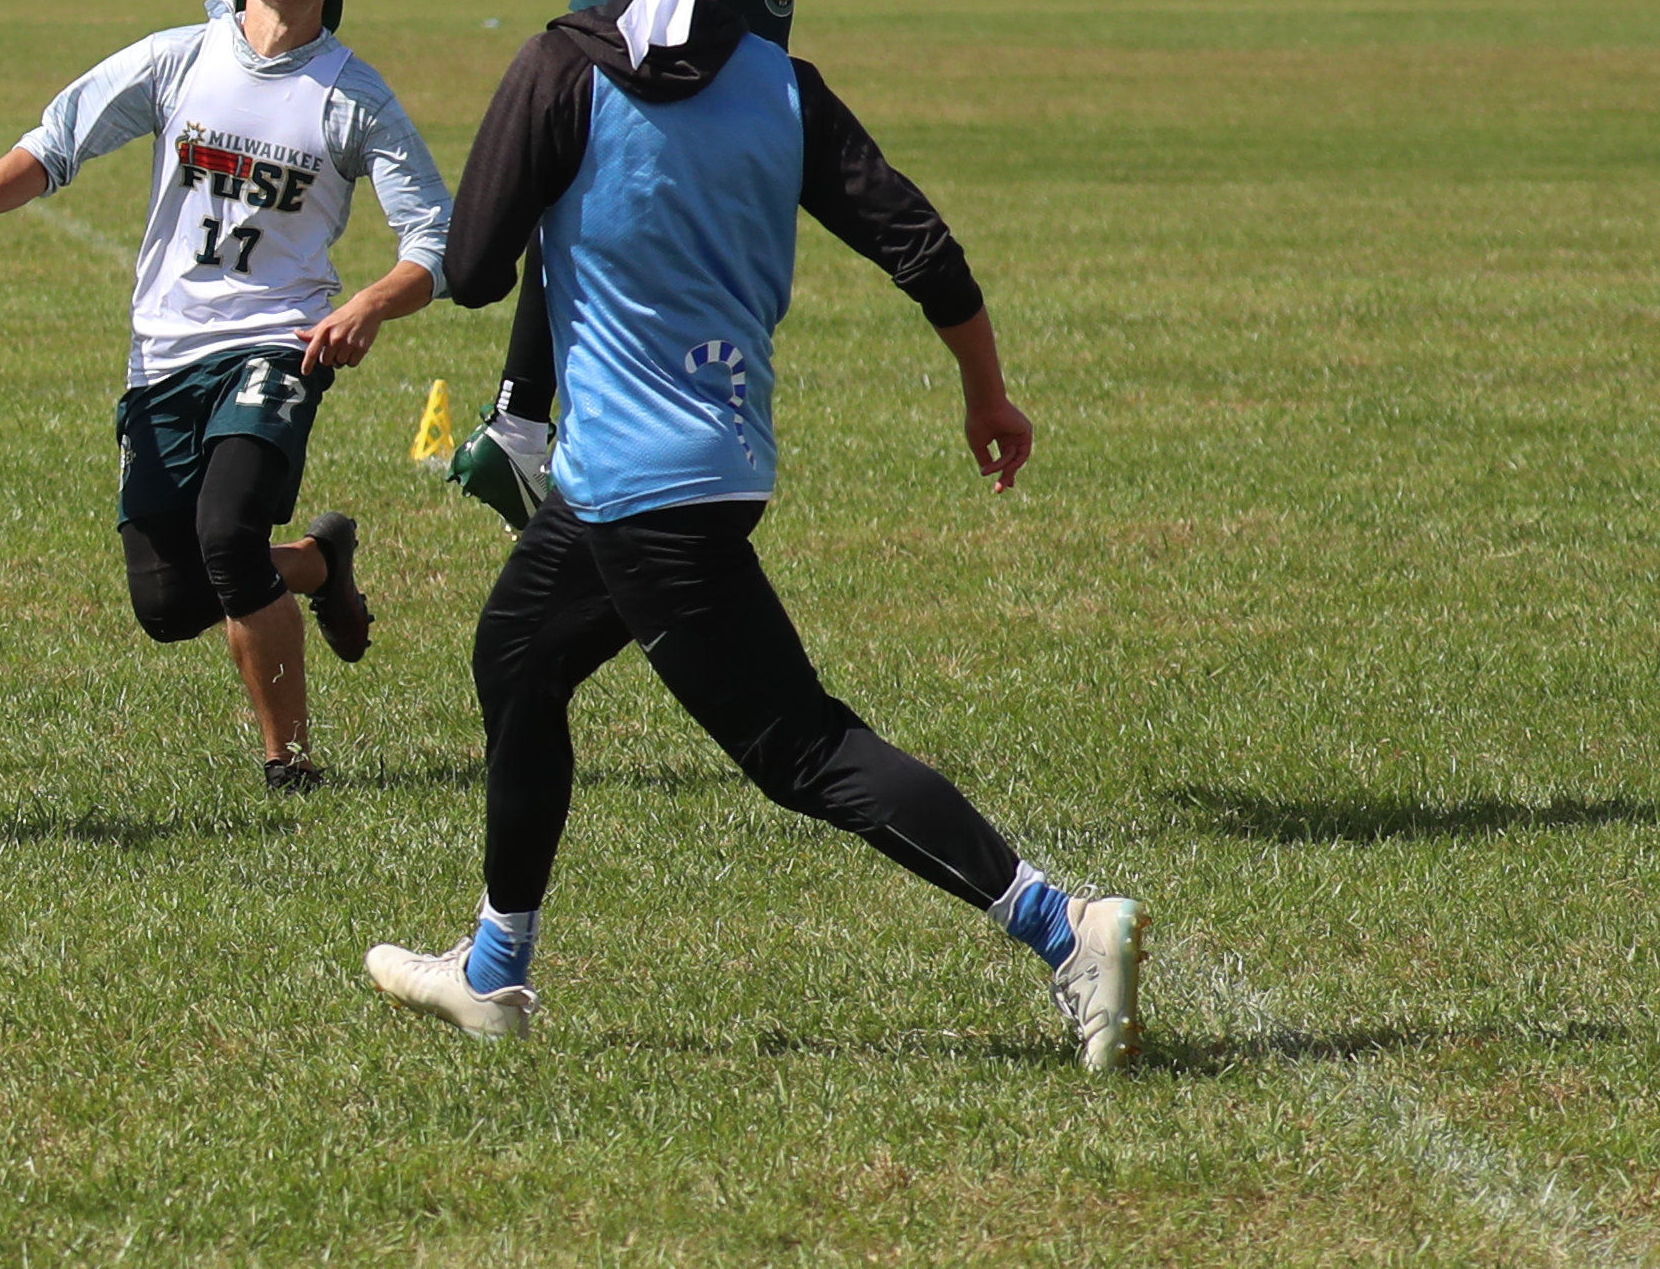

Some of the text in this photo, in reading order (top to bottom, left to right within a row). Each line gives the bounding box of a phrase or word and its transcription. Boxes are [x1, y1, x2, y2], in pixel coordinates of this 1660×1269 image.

[208, 130, 325, 173] MILWAUKEE
[180, 160, 318, 214] FUSE
[195, 214, 265, 274] 17
